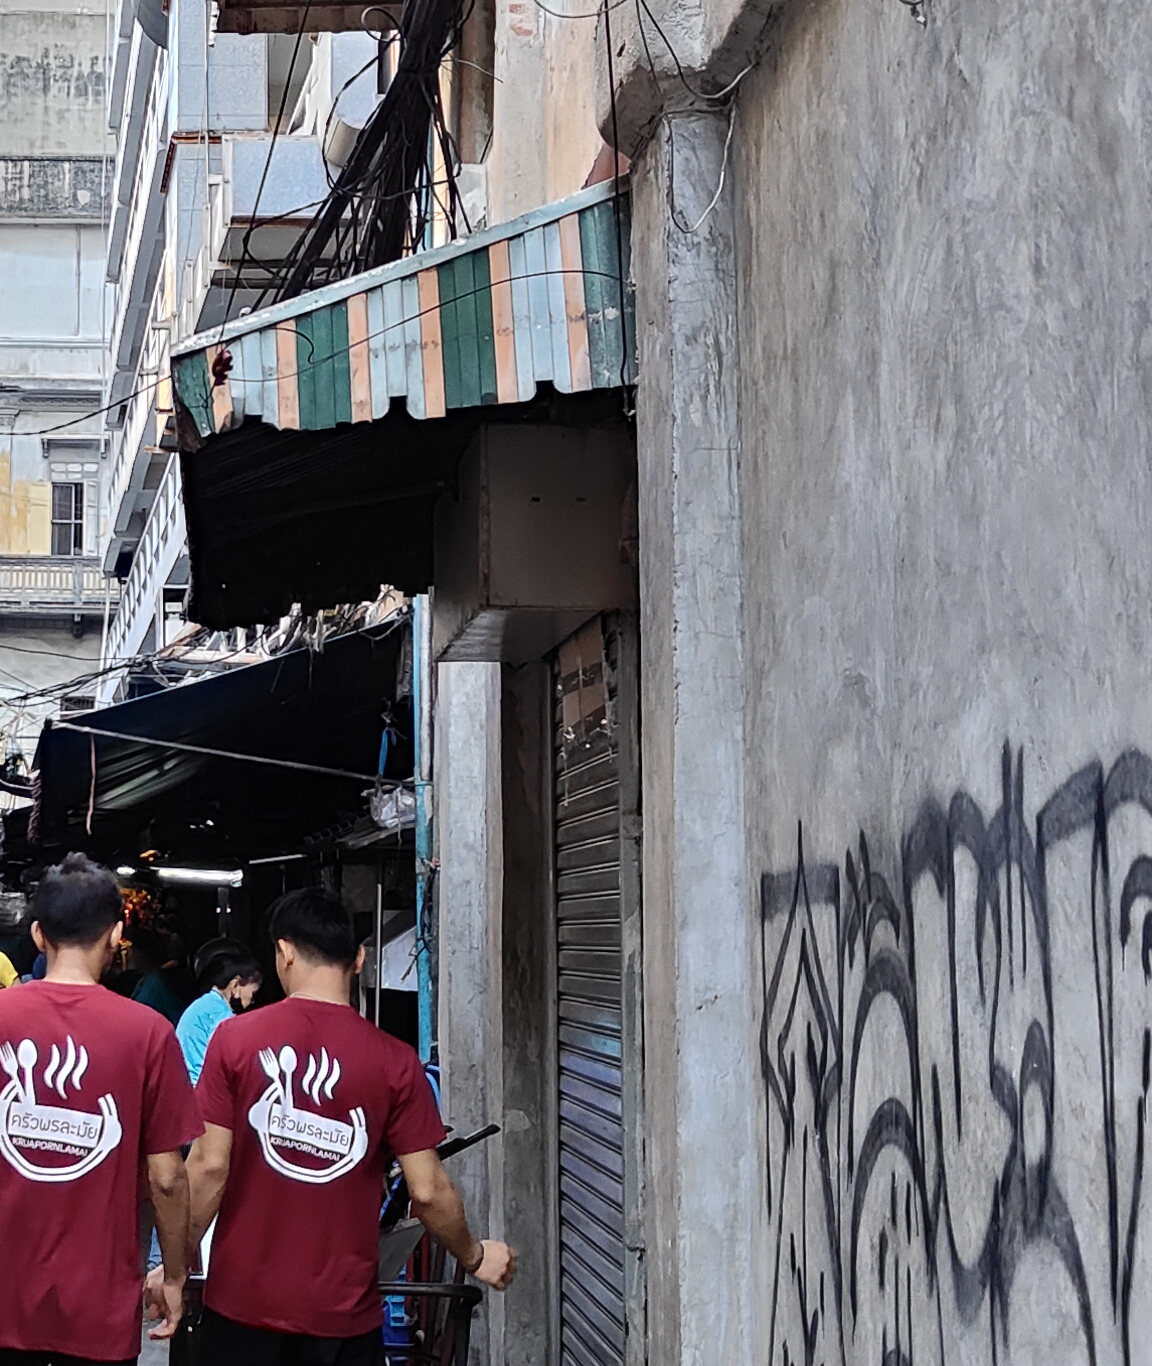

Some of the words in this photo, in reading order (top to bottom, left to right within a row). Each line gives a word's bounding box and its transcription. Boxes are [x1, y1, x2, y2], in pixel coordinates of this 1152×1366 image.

[11, 1112, 98, 1140] ครัวพรละมัย
[271, 1114, 350, 1147] ครัวพรละมัย
